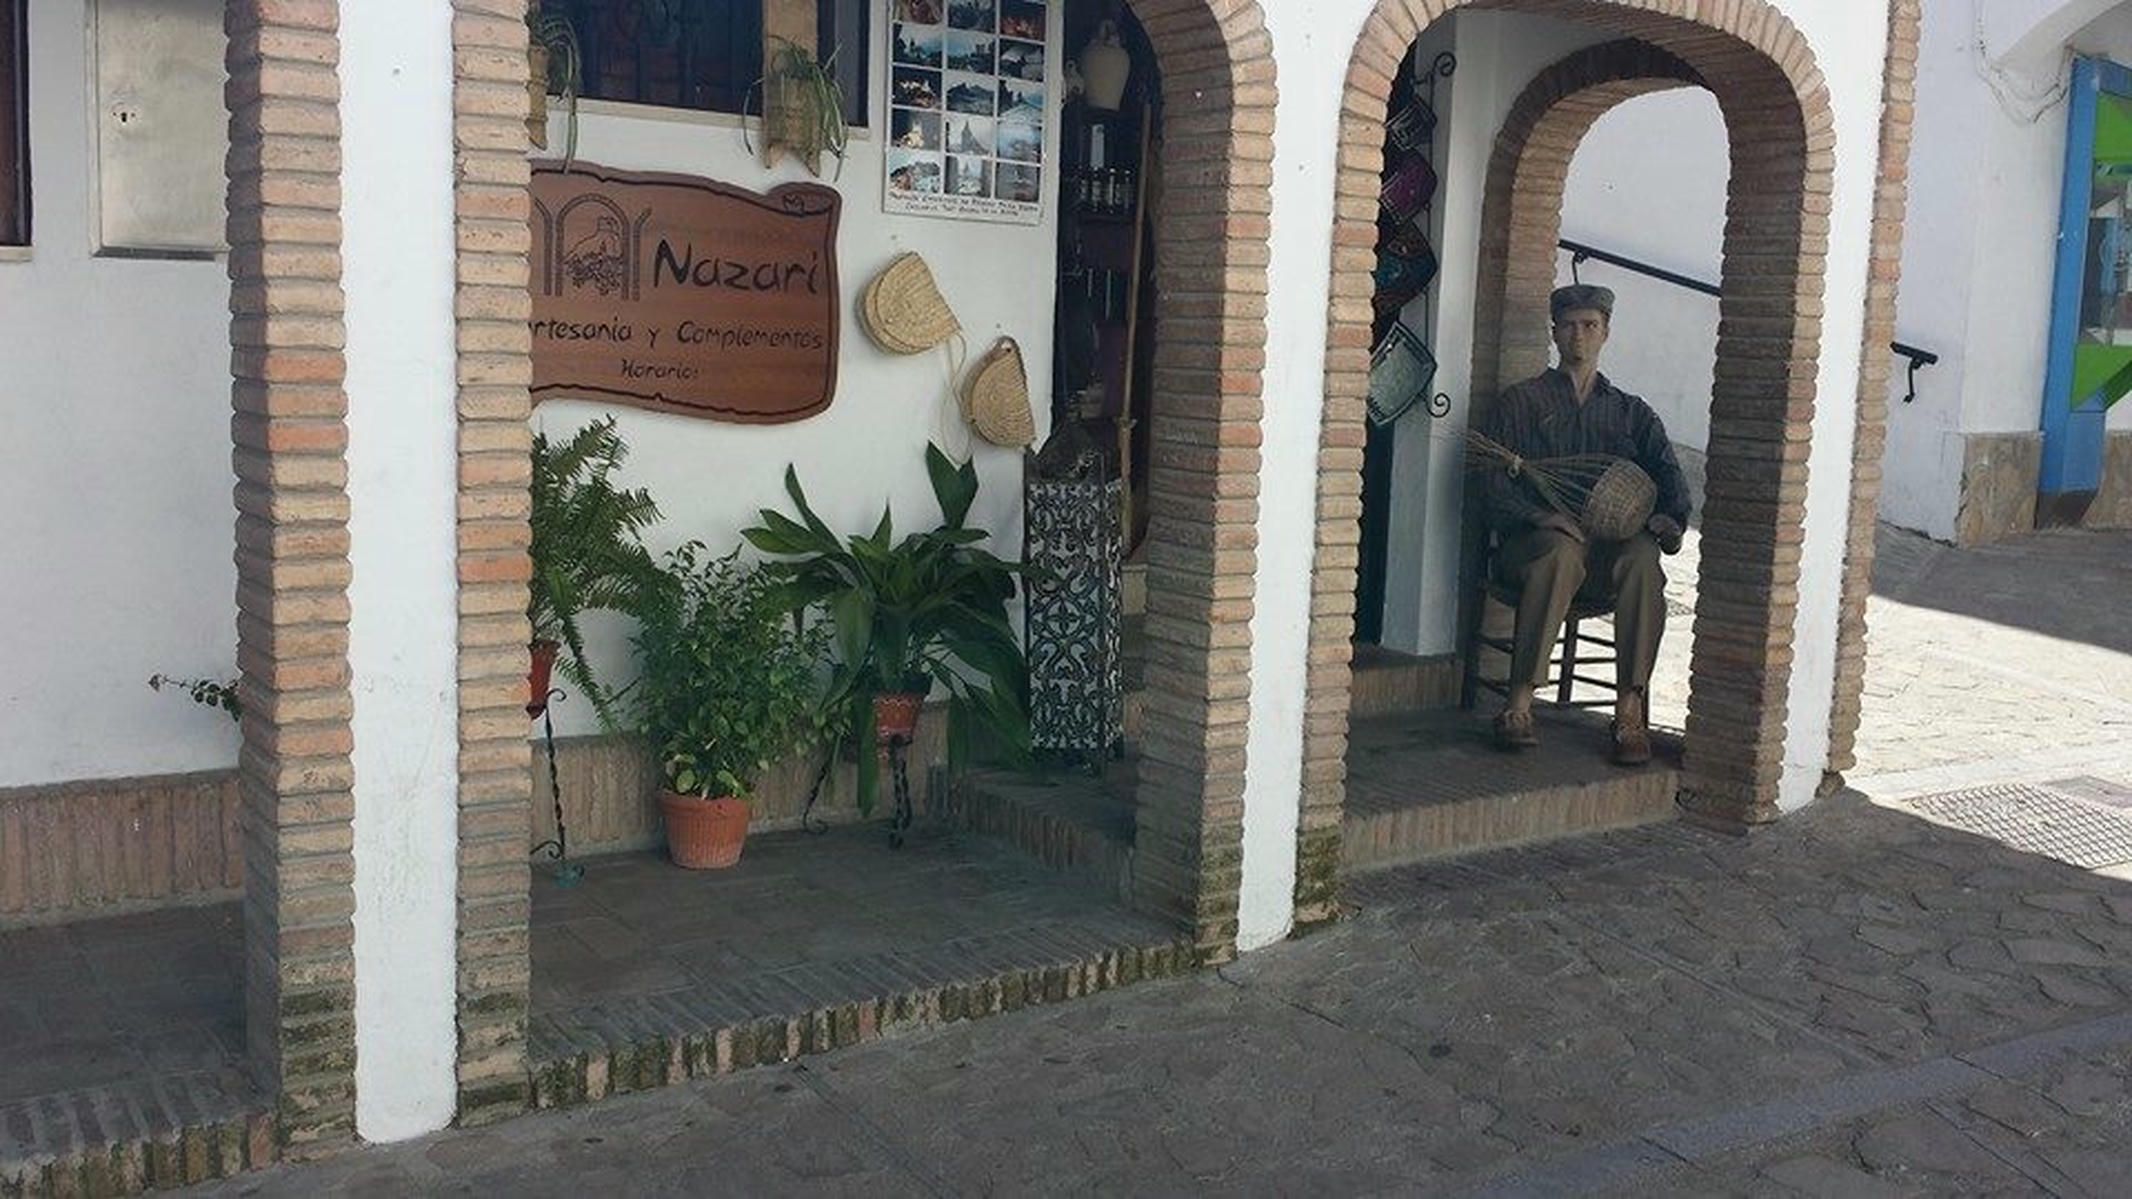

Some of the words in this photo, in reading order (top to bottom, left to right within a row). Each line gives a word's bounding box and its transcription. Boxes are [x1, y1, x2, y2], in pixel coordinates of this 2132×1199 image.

[528, 316, 632, 342] rtesania
[648, 327, 661, 348] y
[677, 320, 824, 349] Complementos
